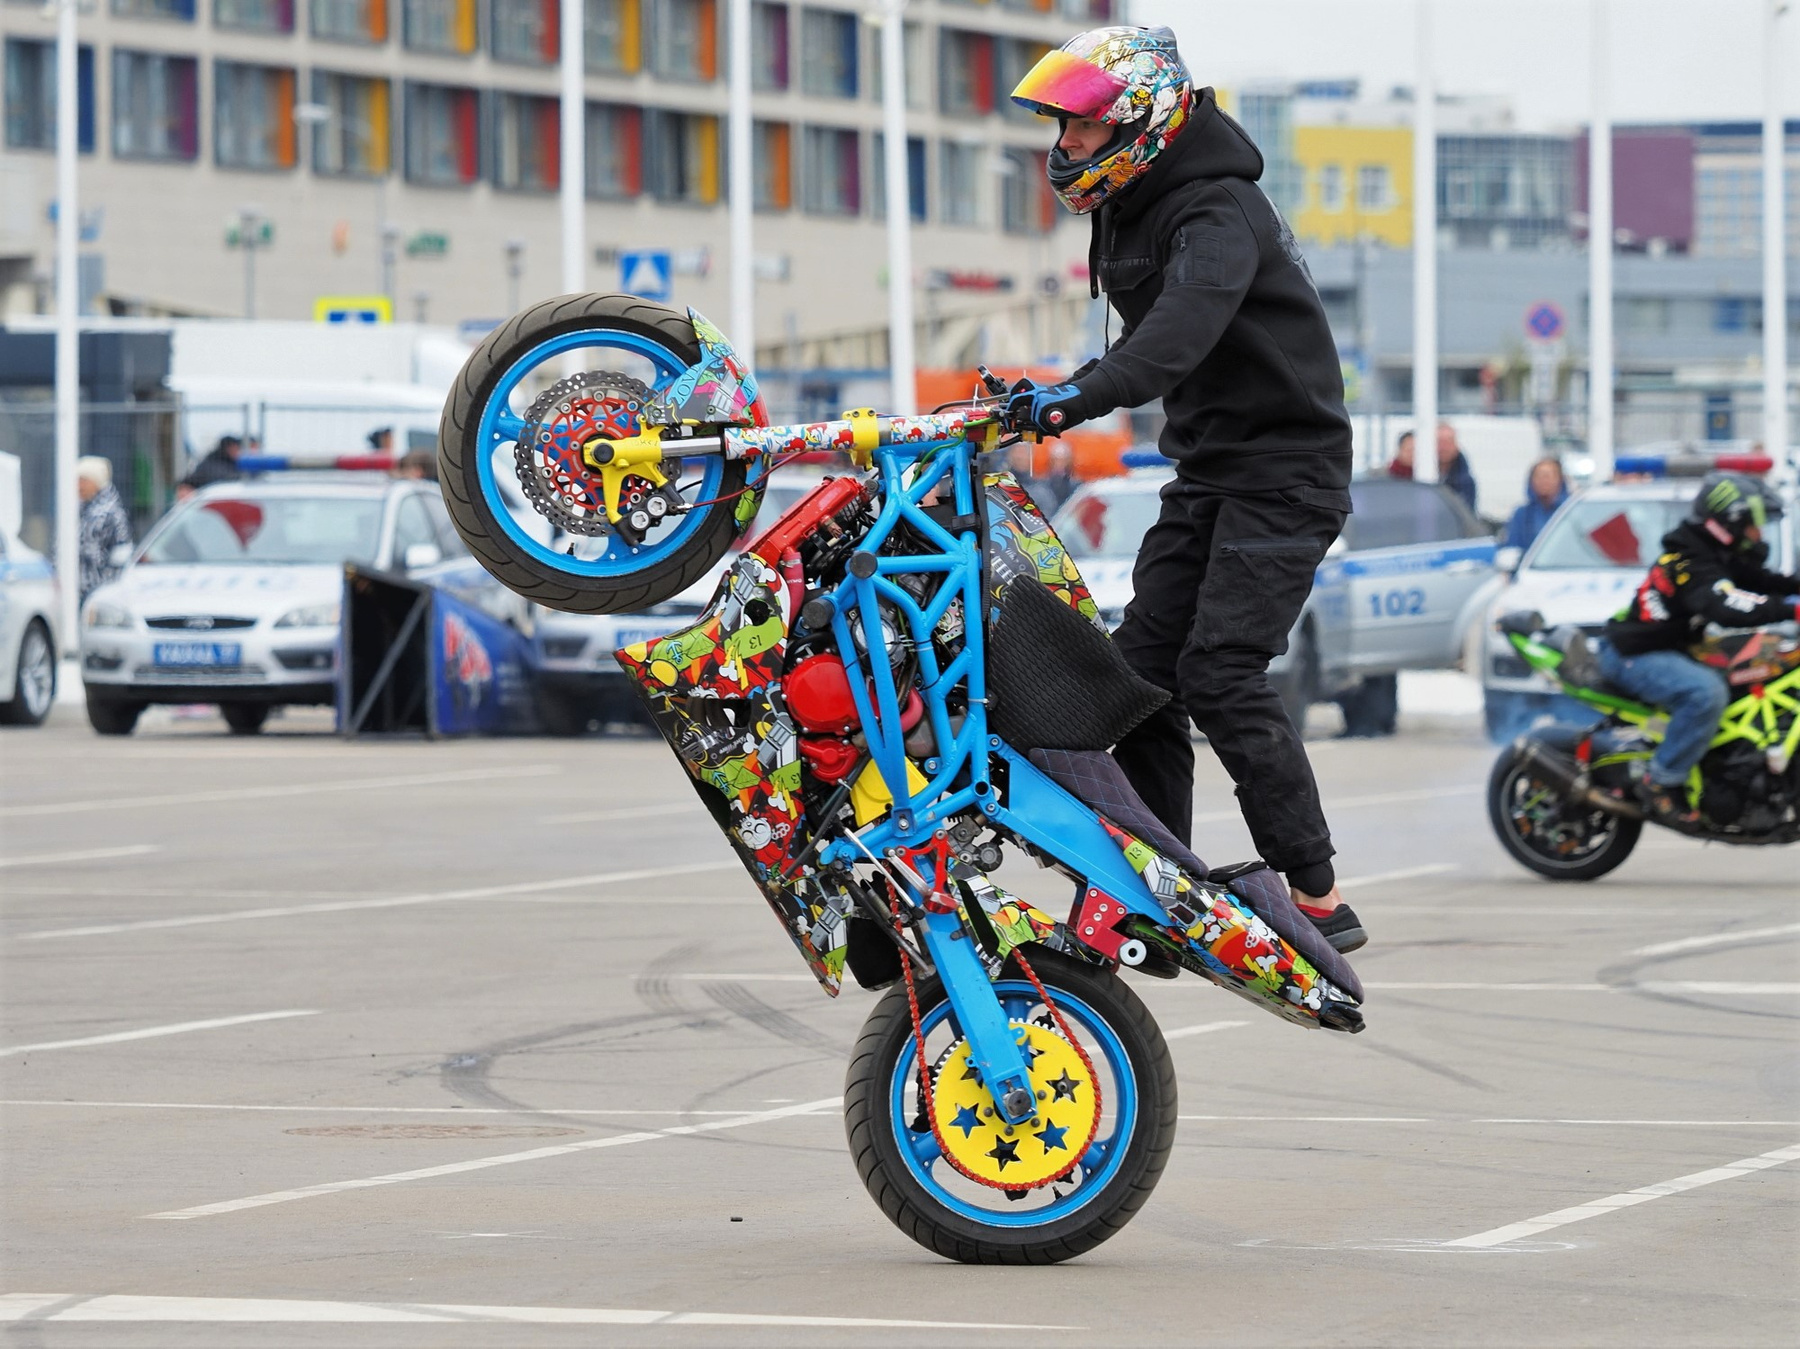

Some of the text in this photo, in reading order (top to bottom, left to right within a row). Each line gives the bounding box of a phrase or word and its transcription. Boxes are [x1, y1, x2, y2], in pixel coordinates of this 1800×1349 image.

[1370, 587, 1426, 617] 102
[749, 635, 762, 650] 13
[1129, 846, 1143, 860] 13
